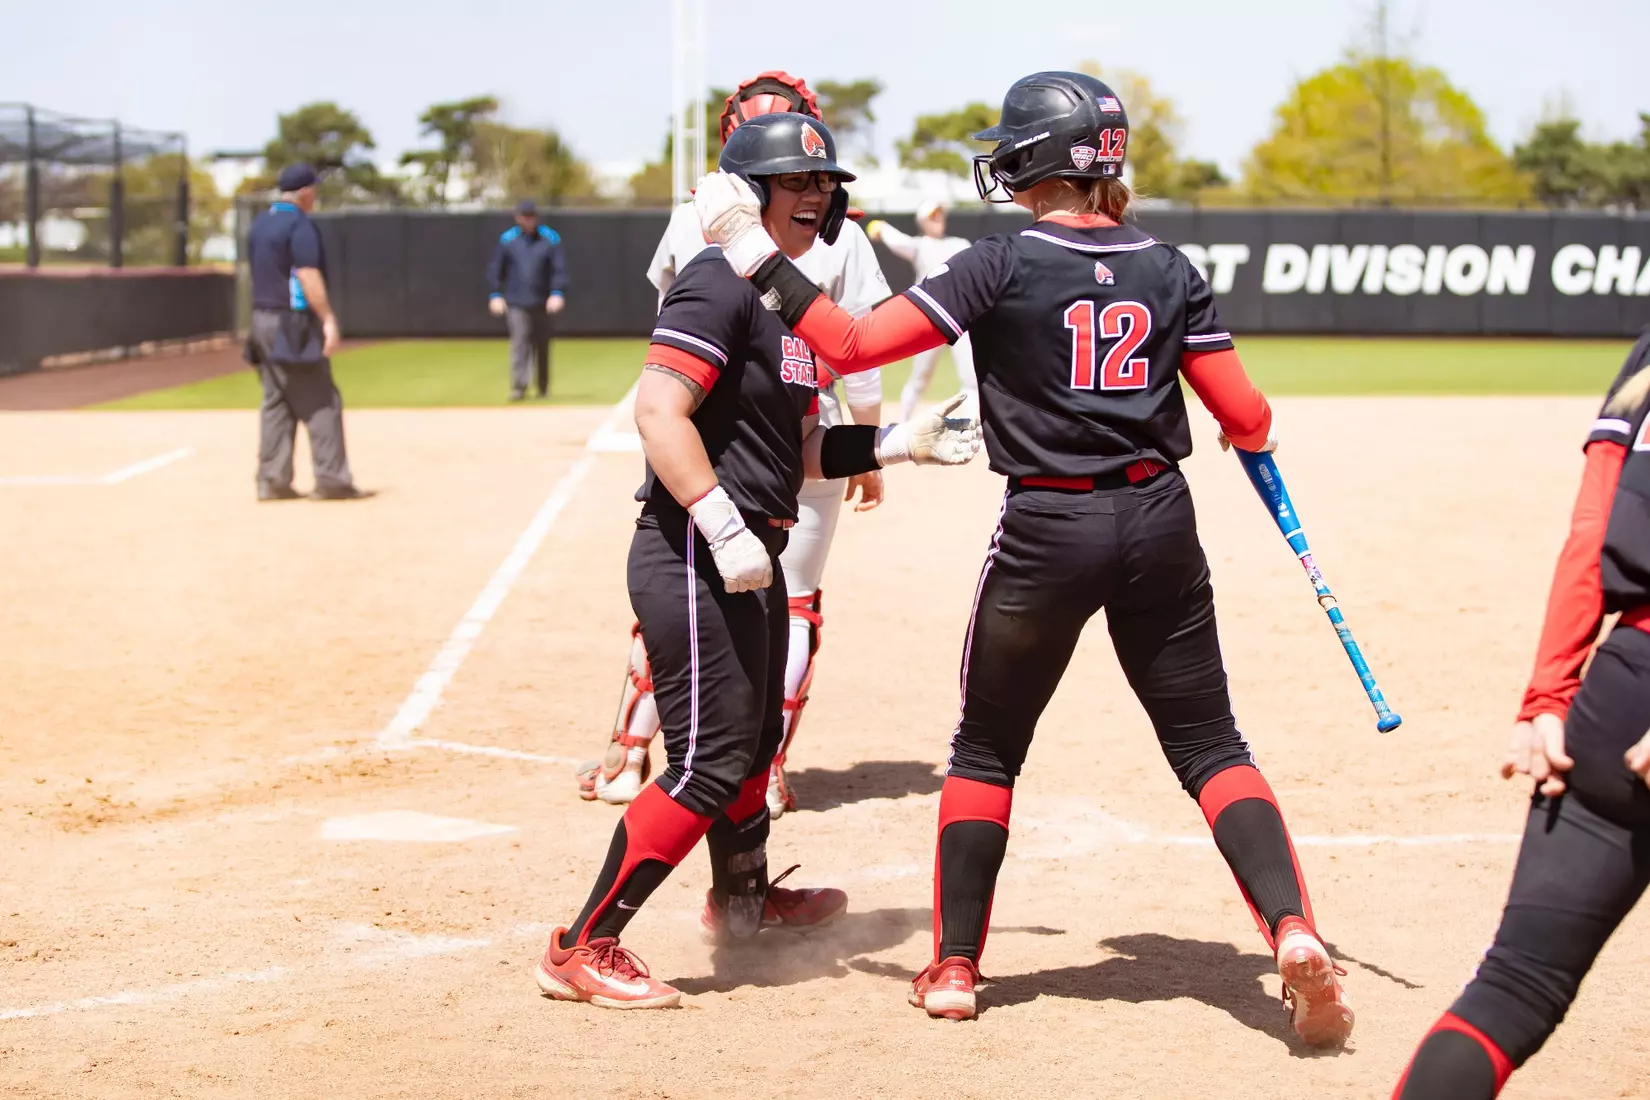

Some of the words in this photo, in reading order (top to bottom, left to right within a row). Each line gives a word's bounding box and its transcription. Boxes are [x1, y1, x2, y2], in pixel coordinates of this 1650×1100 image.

[1098, 128, 1126, 157] 12
[1263, 243, 1536, 296] DIVISION
[1064, 300, 1151, 391] 12
[780, 359, 815, 389] STAT
